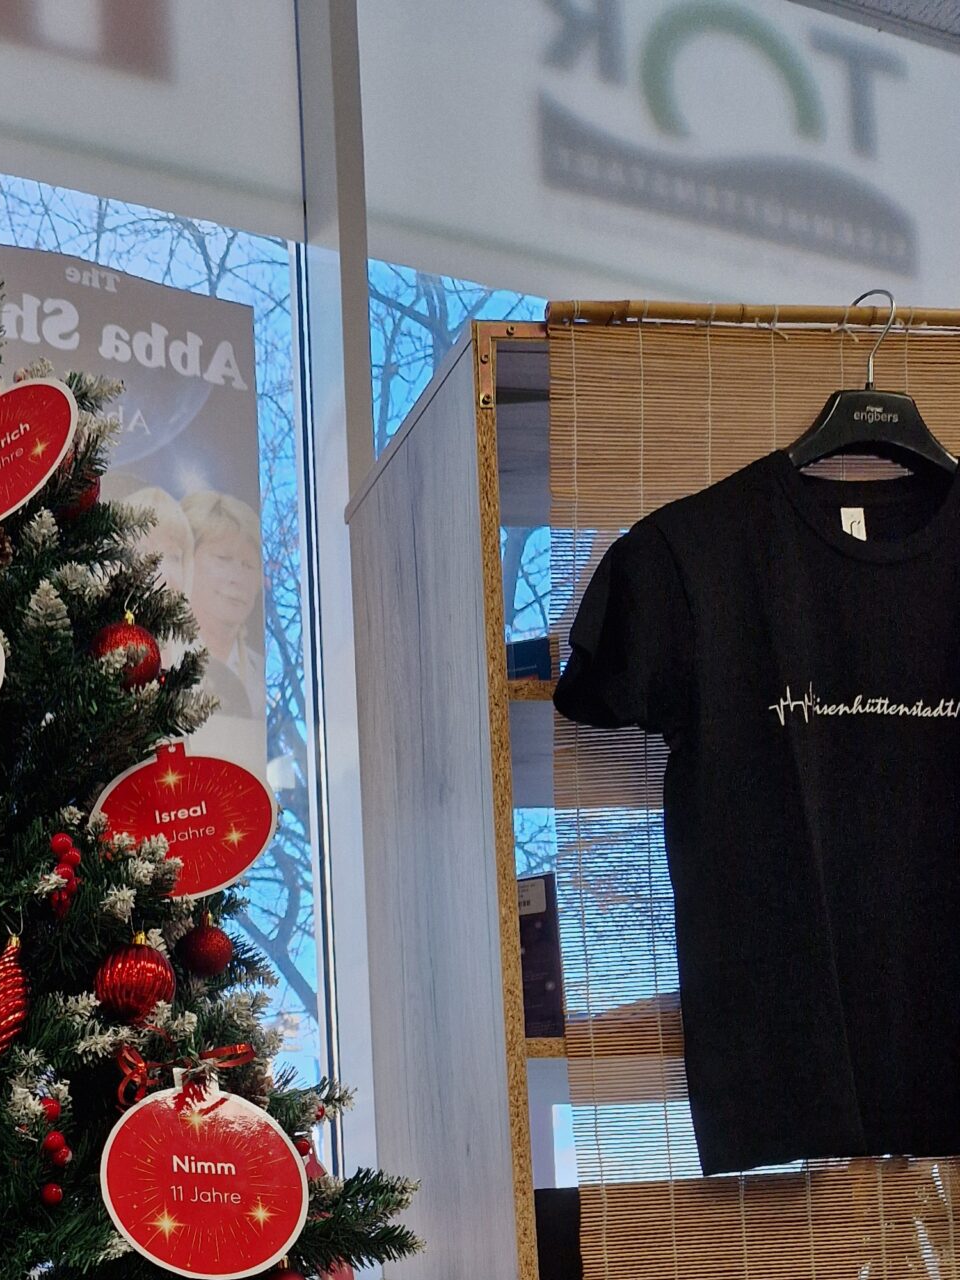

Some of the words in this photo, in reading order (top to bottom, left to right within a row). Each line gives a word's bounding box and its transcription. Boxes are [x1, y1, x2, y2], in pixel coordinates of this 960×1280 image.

[853, 410, 899, 423] engbers
[155, 800, 207, 825] Isreal
[168, 826, 216, 844] Jahre
[172, 1155, 236, 1175] Nimm
[170, 1186, 183, 1201] 11
[190, 1187, 241, 1204] Jahre
